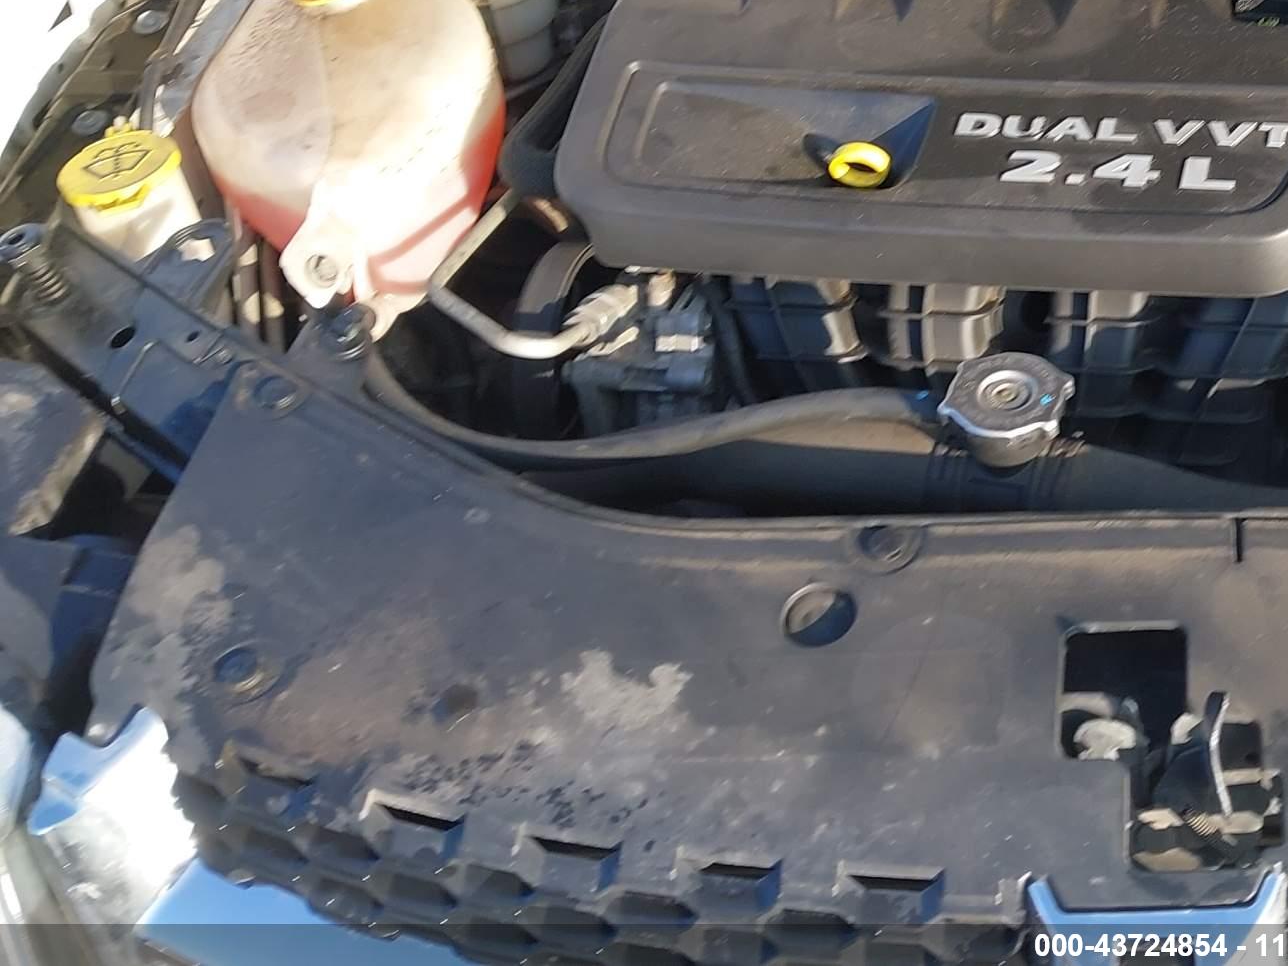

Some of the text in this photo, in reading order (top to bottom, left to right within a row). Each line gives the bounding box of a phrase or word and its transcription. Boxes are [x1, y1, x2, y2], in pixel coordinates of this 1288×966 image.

[954, 112, 1139, 144] DUAL
[999, 150, 1237, 192] 2.4 L
